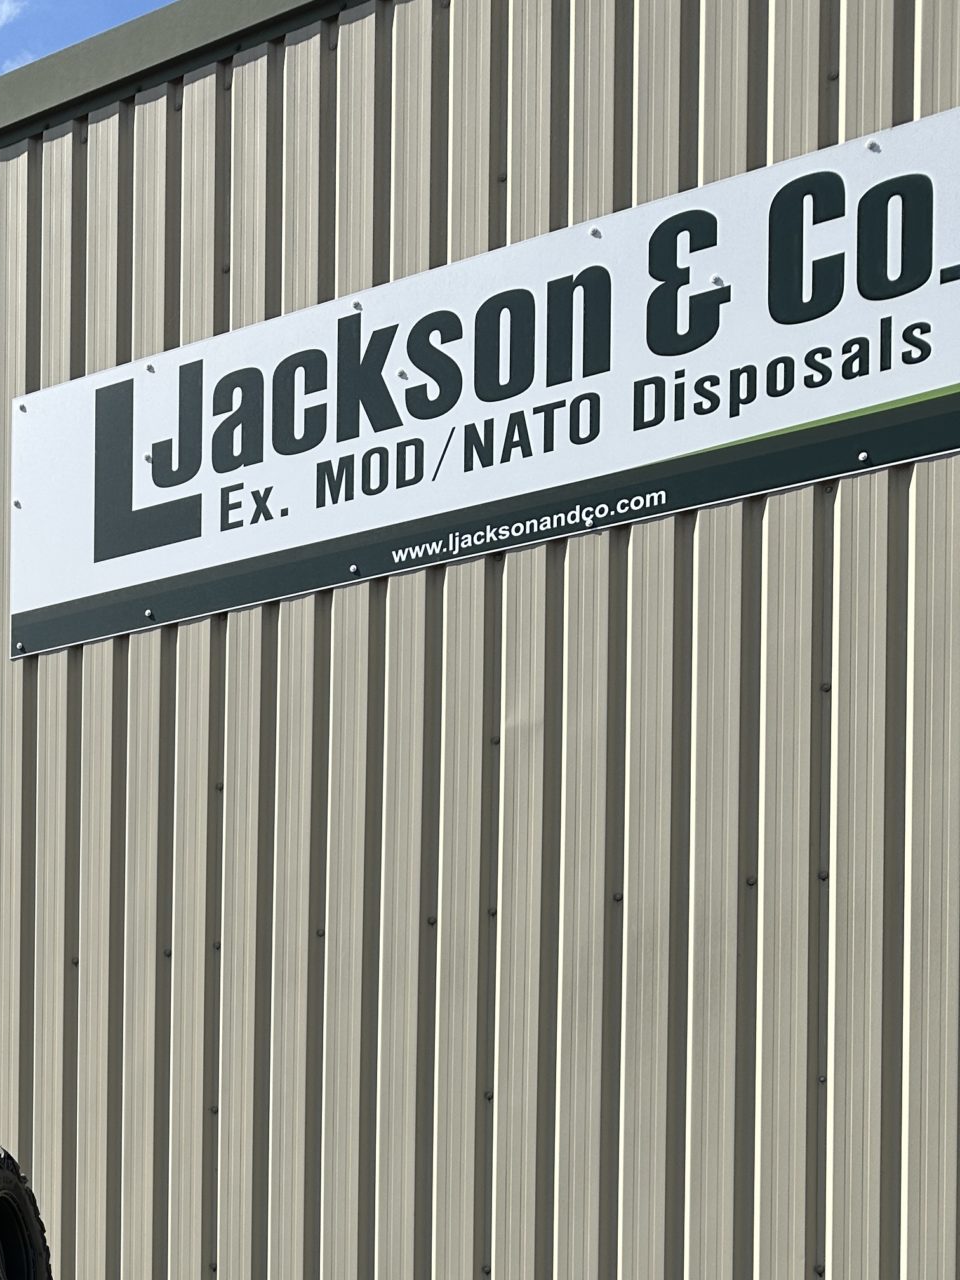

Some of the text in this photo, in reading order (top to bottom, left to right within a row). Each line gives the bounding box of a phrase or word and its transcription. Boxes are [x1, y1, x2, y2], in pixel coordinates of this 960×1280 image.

[646, 209, 731, 356] &
[220, 315, 932, 532] Ex. MOD/NATO Disposals
[392, 490, 667, 564] www.ljacksonandco.com
